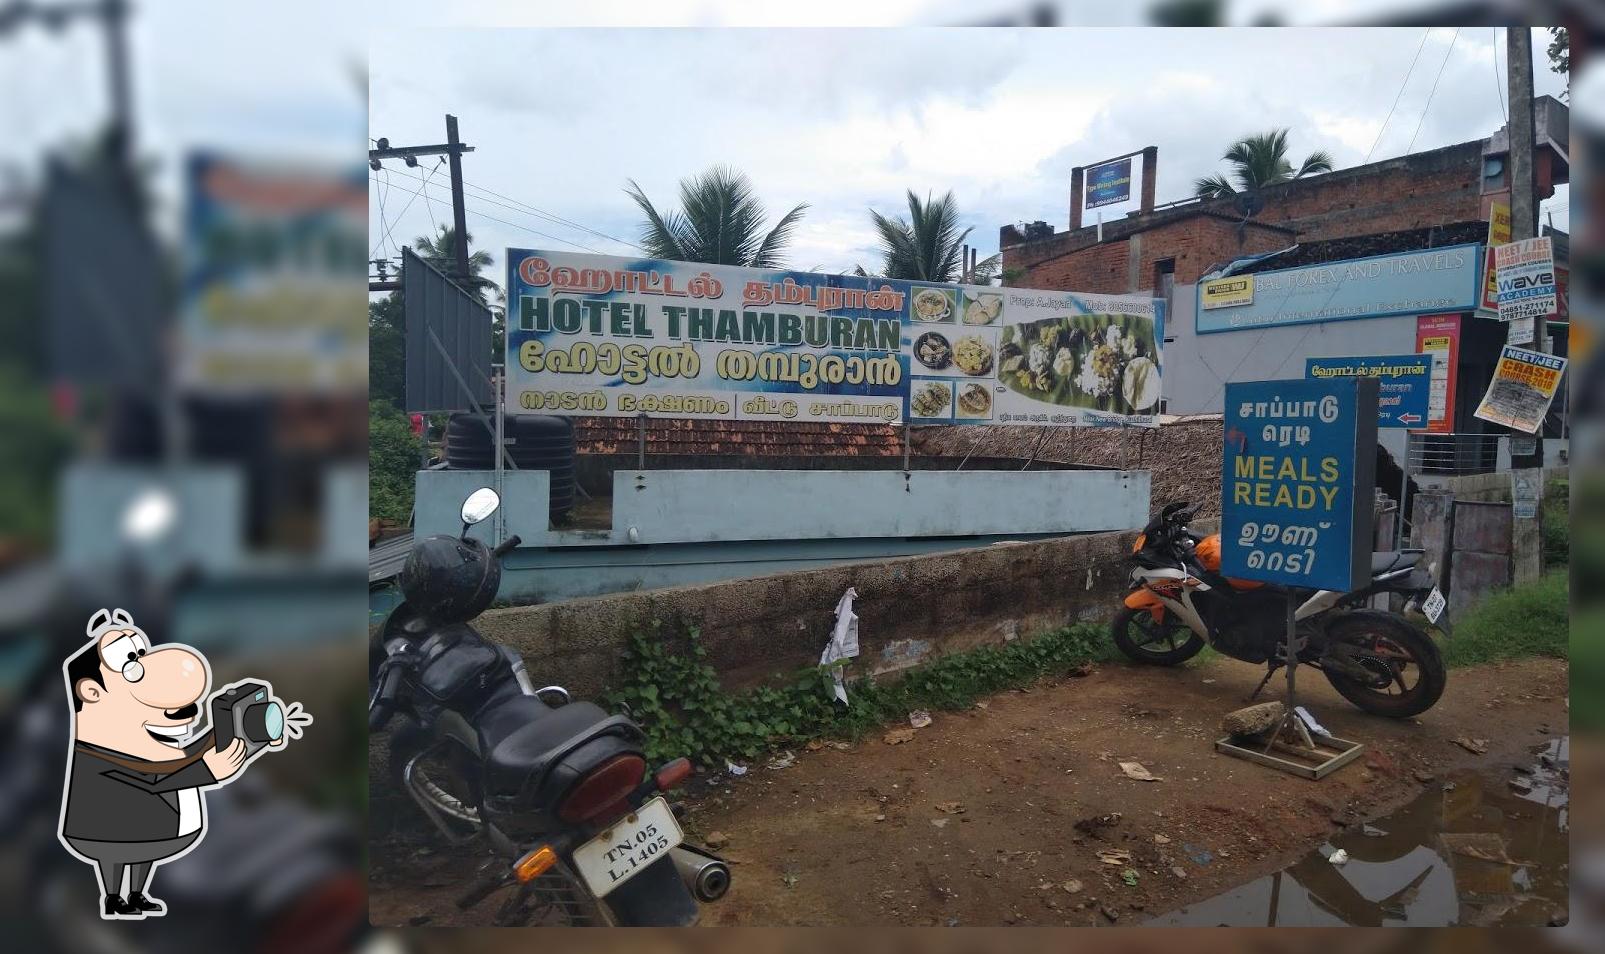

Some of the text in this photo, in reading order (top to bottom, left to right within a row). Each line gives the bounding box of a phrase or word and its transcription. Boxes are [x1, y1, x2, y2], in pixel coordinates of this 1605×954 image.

[1497, 243, 1521, 257] NEET
[1532, 239, 1549, 250] JEE
[1497, 256, 1521, 267] CRASH
[519, 256, 907, 313] ஹோட்டல் தம்புரான்
[1256, 250, 1465, 292] BAL FOREX AND TRAVELS
[1499, 286, 1553, 301] ACADEMY
[519, 295, 901, 352] HOTEL THAMBURAN
[519, 340, 700, 384] ഹോട്ടൽ
[1502, 360, 1557, 381] CRASH
[1506, 350, 1561, 369] NEET/JEE
[519, 389, 607, 411] നാടൻ
[1239, 394, 1339, 424] சாப்பாடு
[1262, 424, 1310, 447] ரெடி
[1235, 455, 1340, 482] MEALS
[1234, 481, 1340, 511] READY
[602, 823, 658, 865] TN.05
[607, 835, 669, 883] L.1405
